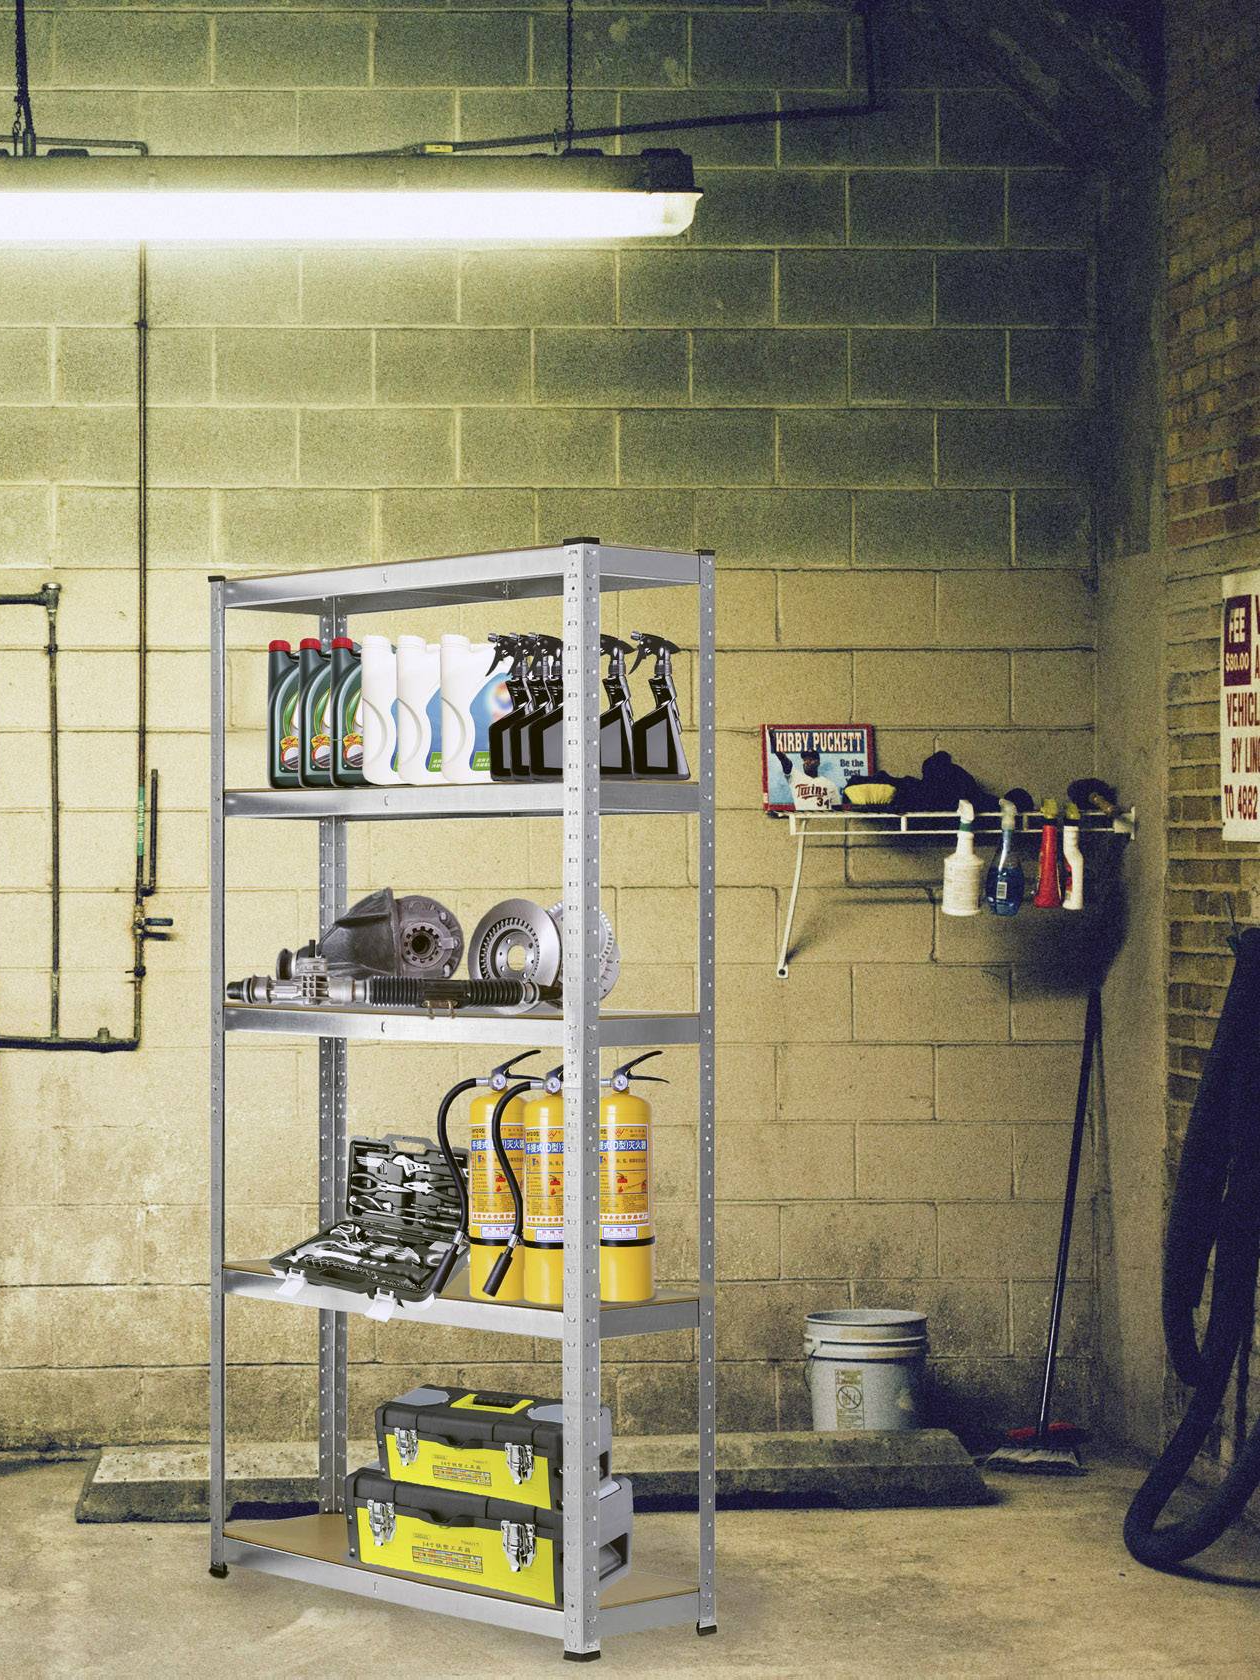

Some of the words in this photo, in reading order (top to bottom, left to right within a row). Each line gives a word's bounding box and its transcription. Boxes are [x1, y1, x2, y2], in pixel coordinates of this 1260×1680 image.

[1229, 607, 1246, 643] FEE
[775, 732, 809, 752] KIRBY
[813, 732, 862, 752] PUCKETT
[840, 758, 850, 768] Be
[851, 758, 865, 768] the
[1232, 737, 1242, 773] BY
[795, 783, 828, 801] Twins
[1224, 784, 1234, 819] TO
[816, 797, 830, 810] 34
